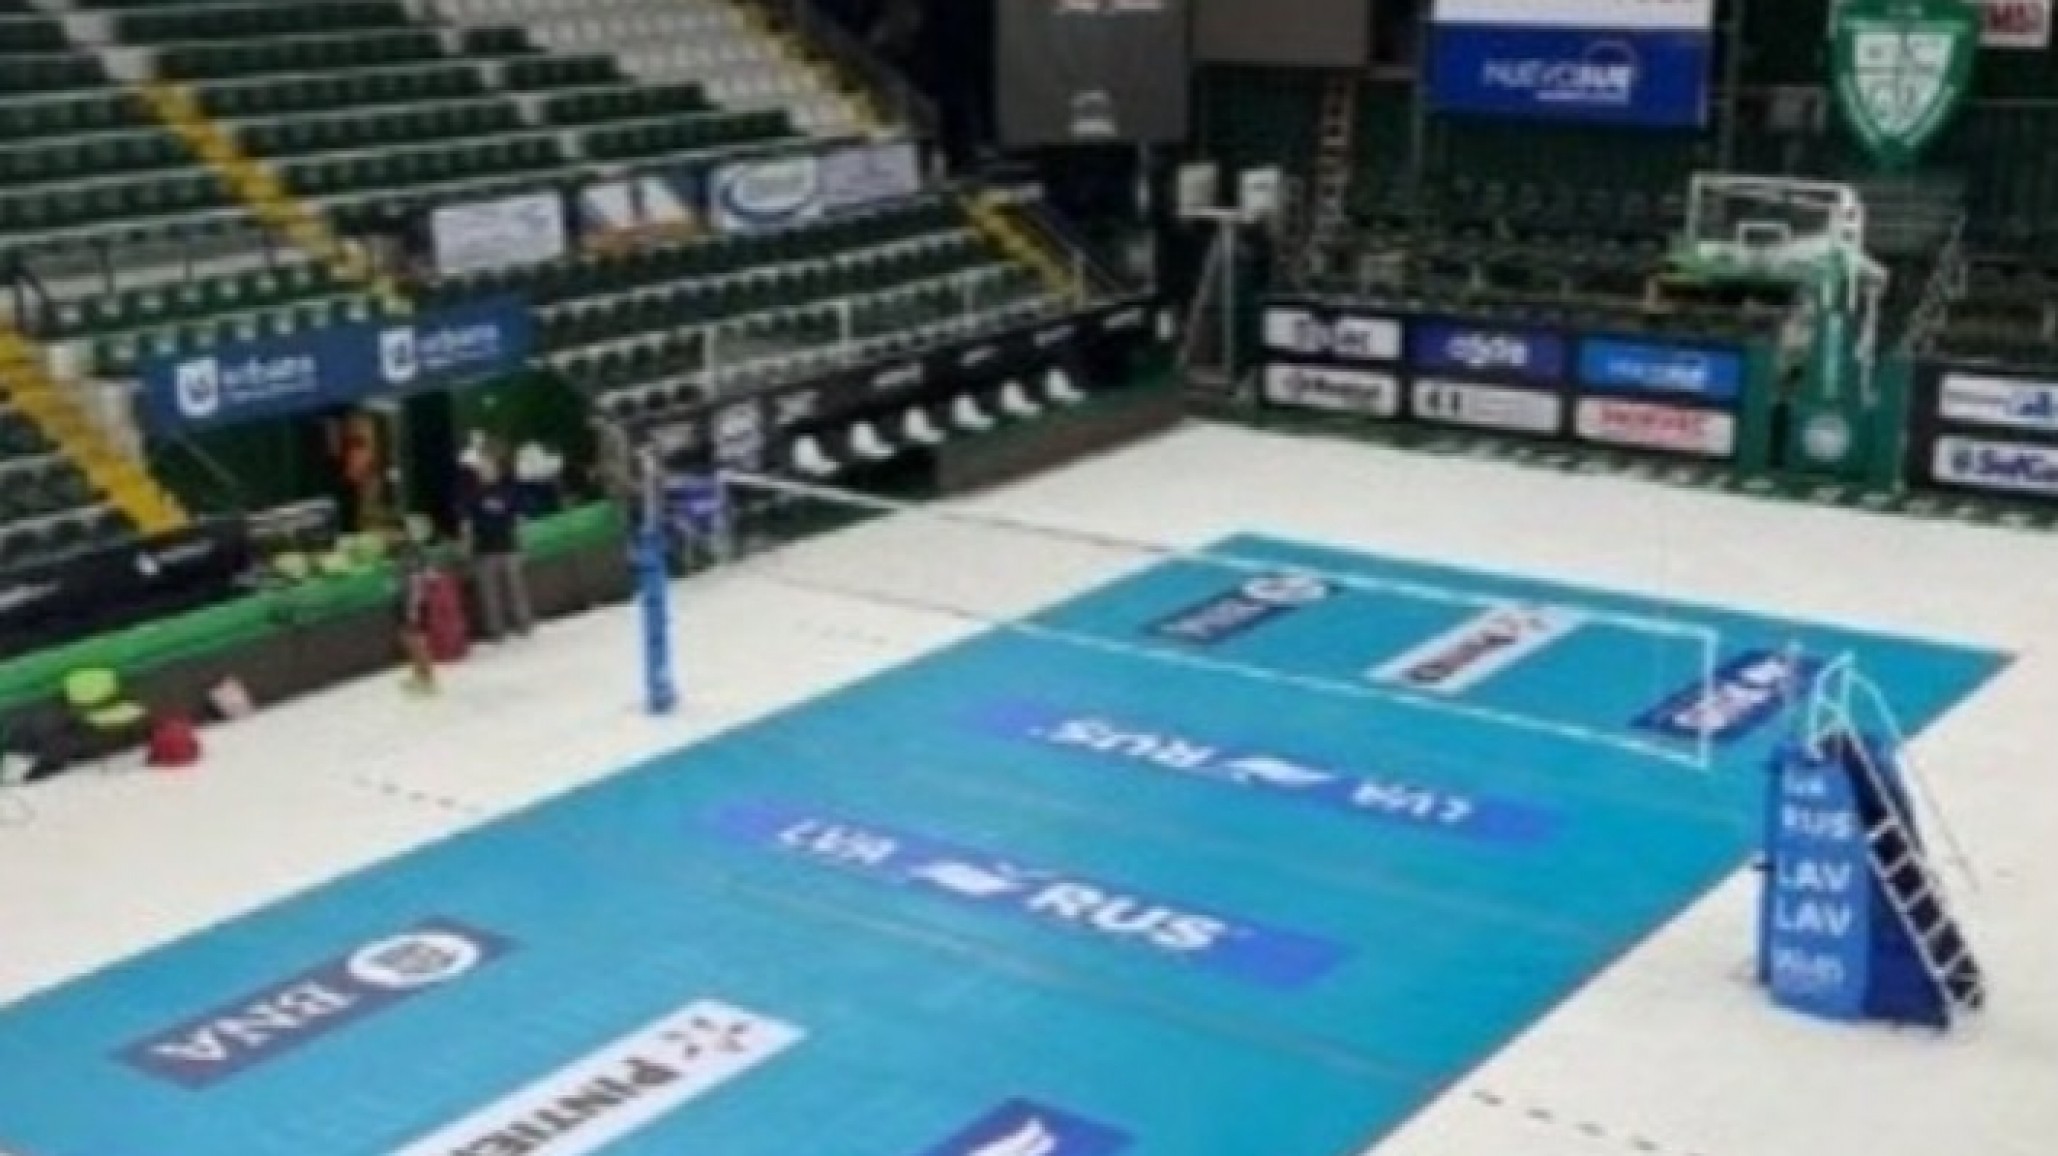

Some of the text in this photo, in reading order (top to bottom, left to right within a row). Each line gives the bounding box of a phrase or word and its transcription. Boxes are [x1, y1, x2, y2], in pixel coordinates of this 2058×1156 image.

[1778, 858, 1851, 893] LAV
[1025, 880, 1232, 952] RUS
[1774, 896, 1851, 937] LAV
[152, 984, 355, 1062] BNA
